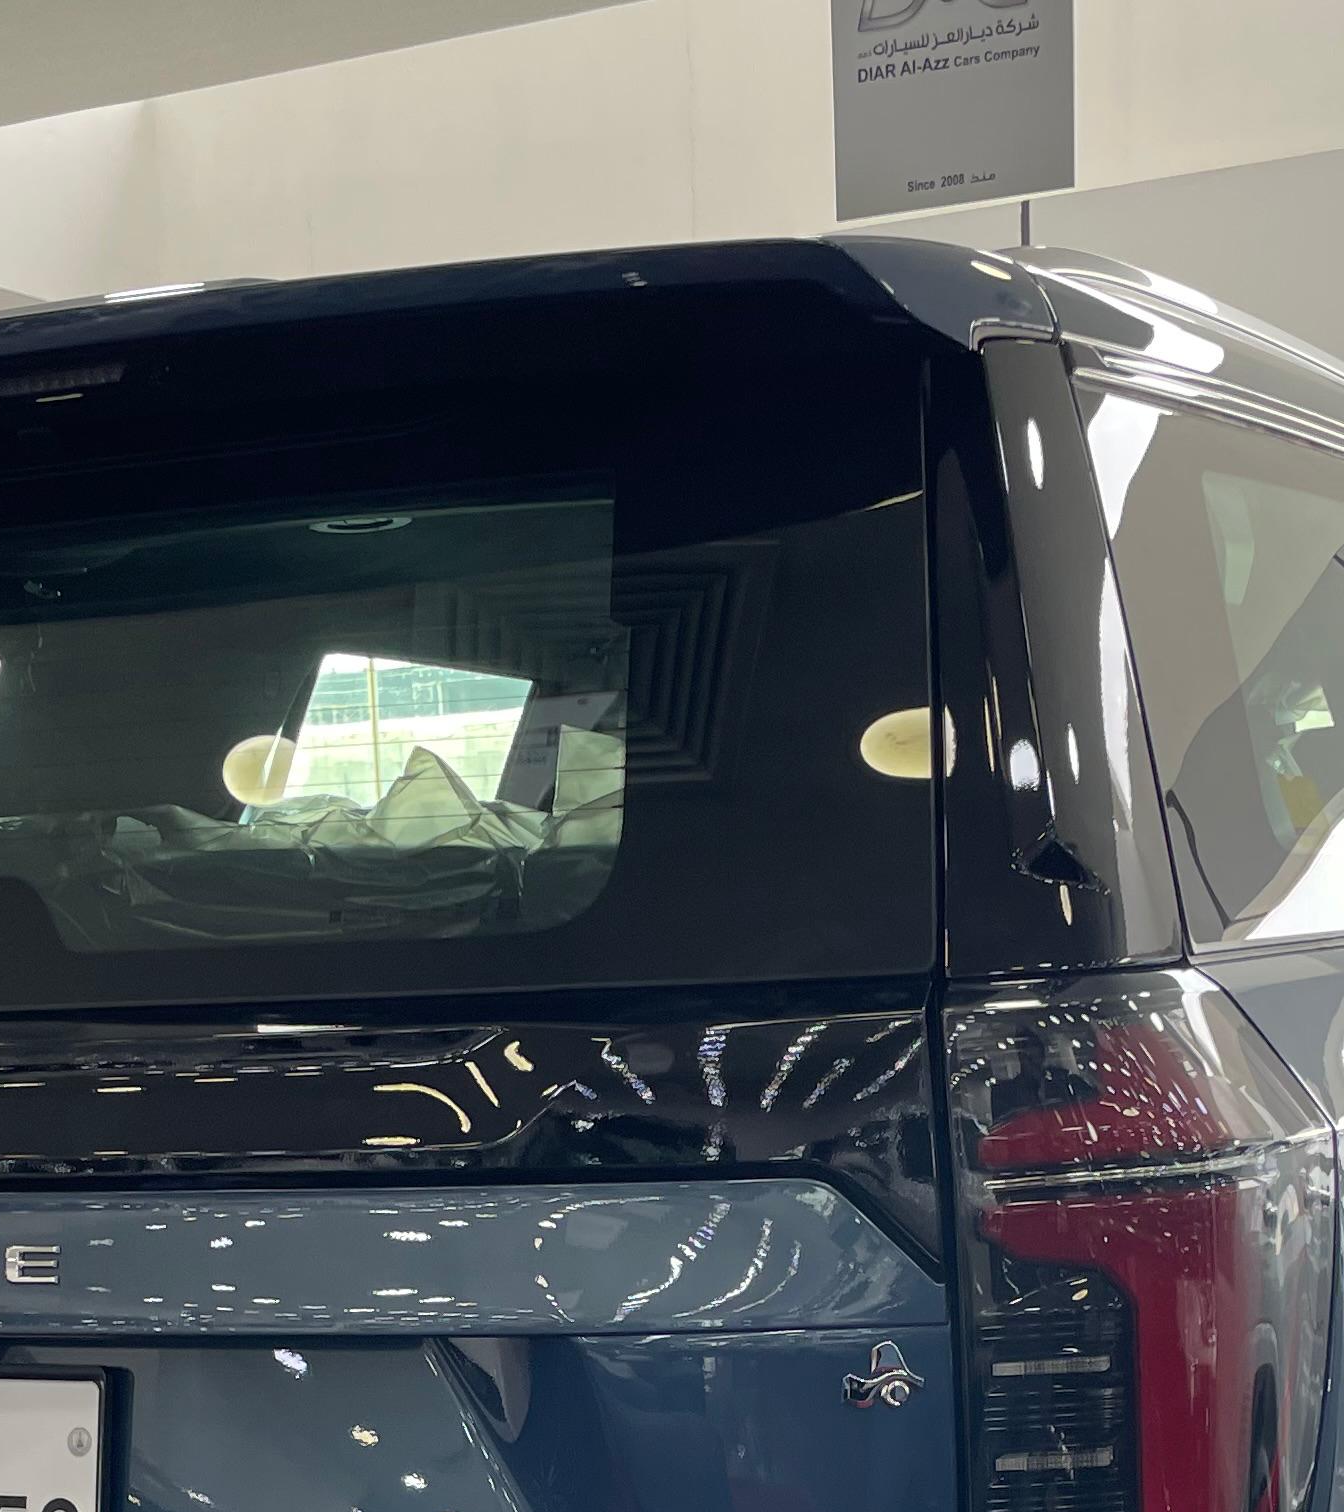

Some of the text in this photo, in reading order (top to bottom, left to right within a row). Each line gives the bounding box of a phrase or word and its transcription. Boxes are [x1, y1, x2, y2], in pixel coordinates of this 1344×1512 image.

[996, 13, 1040, 36] شركة
[873, 33, 930, 58] للسيارات
[857, 46, 1041, 83] DIAR Al-Azz Cars Company
[907, 178, 935, 193] Since
[940, 173, 966, 188] 2008
